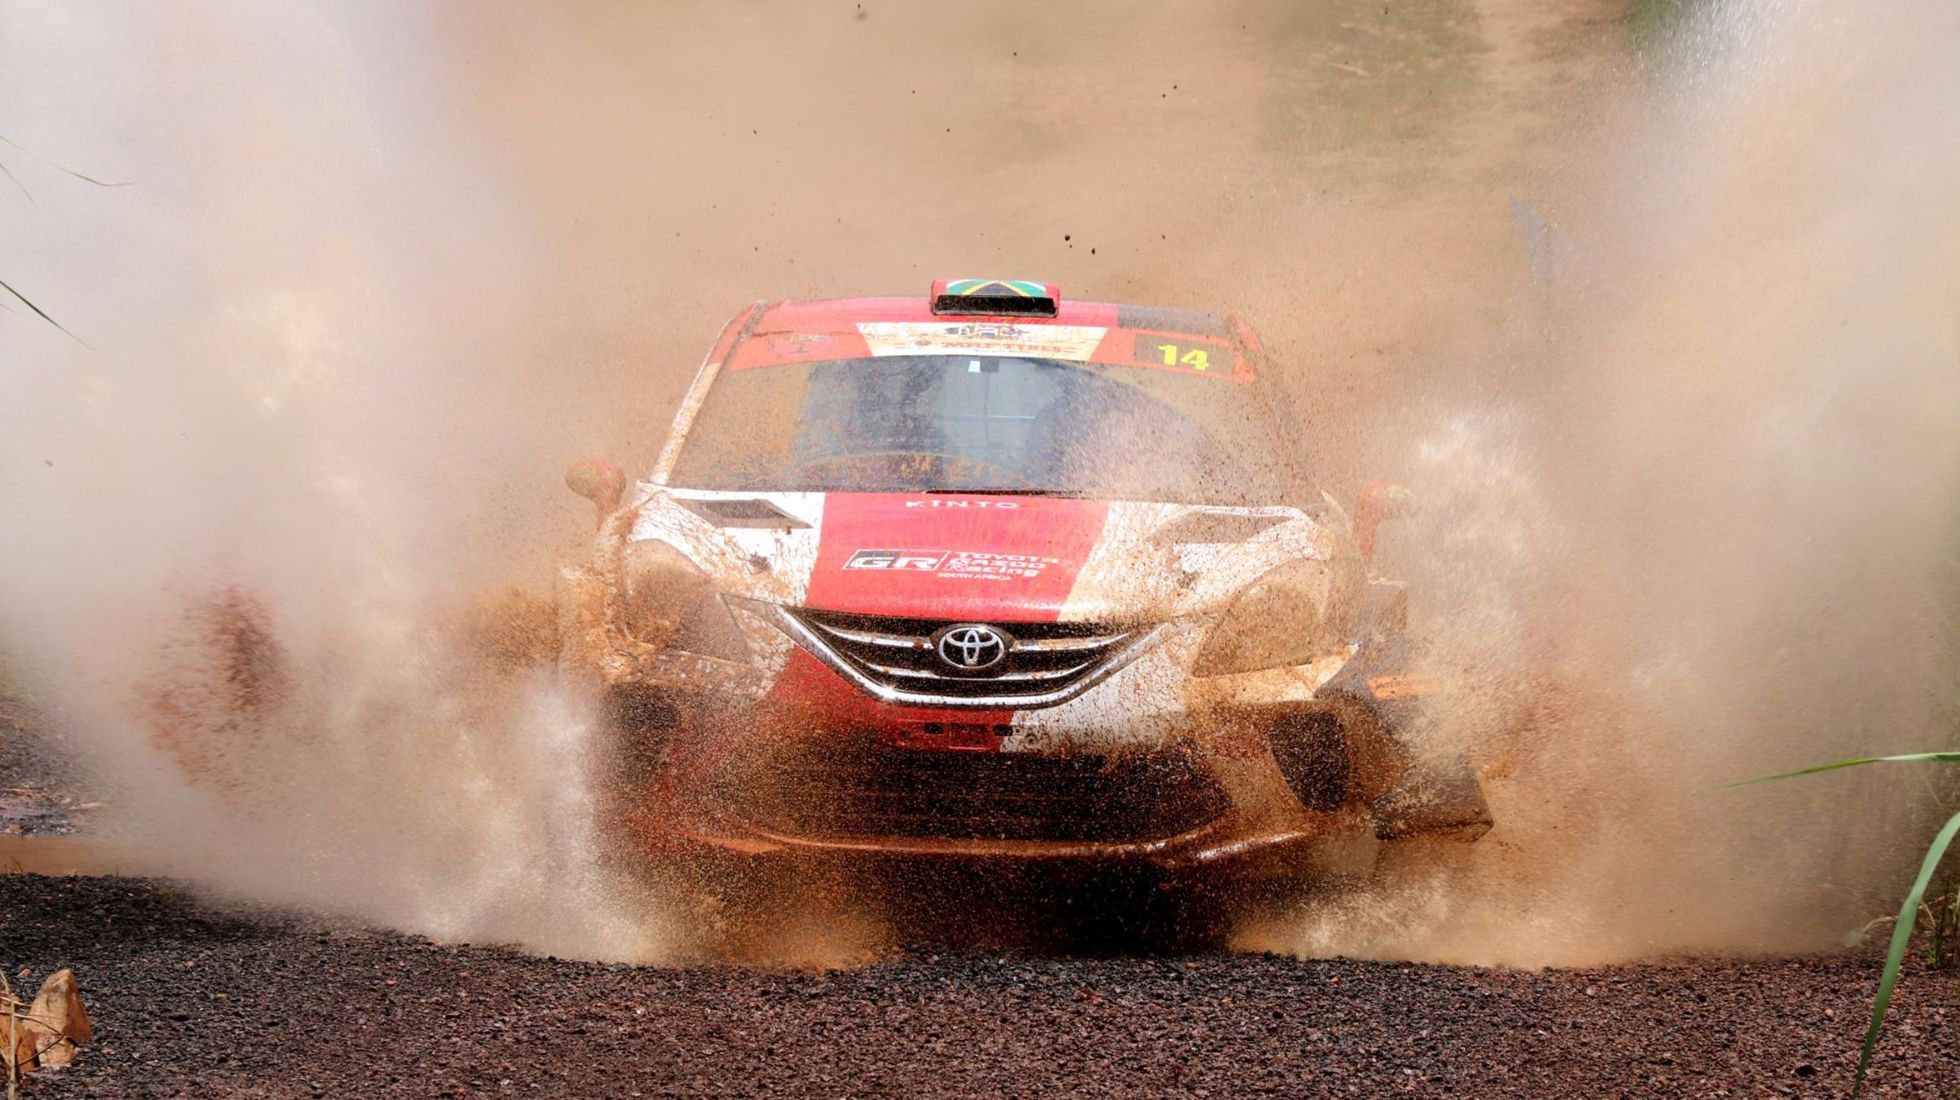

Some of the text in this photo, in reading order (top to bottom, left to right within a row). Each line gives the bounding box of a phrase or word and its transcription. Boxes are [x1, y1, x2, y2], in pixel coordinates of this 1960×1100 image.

[1158, 345, 1209, 371] 14
[905, 500, 1019, 509] KINTO
[850, 557, 938, 570] GR
[949, 557, 1047, 569] GAZOO
[955, 551, 1059, 564] TOYOTA
